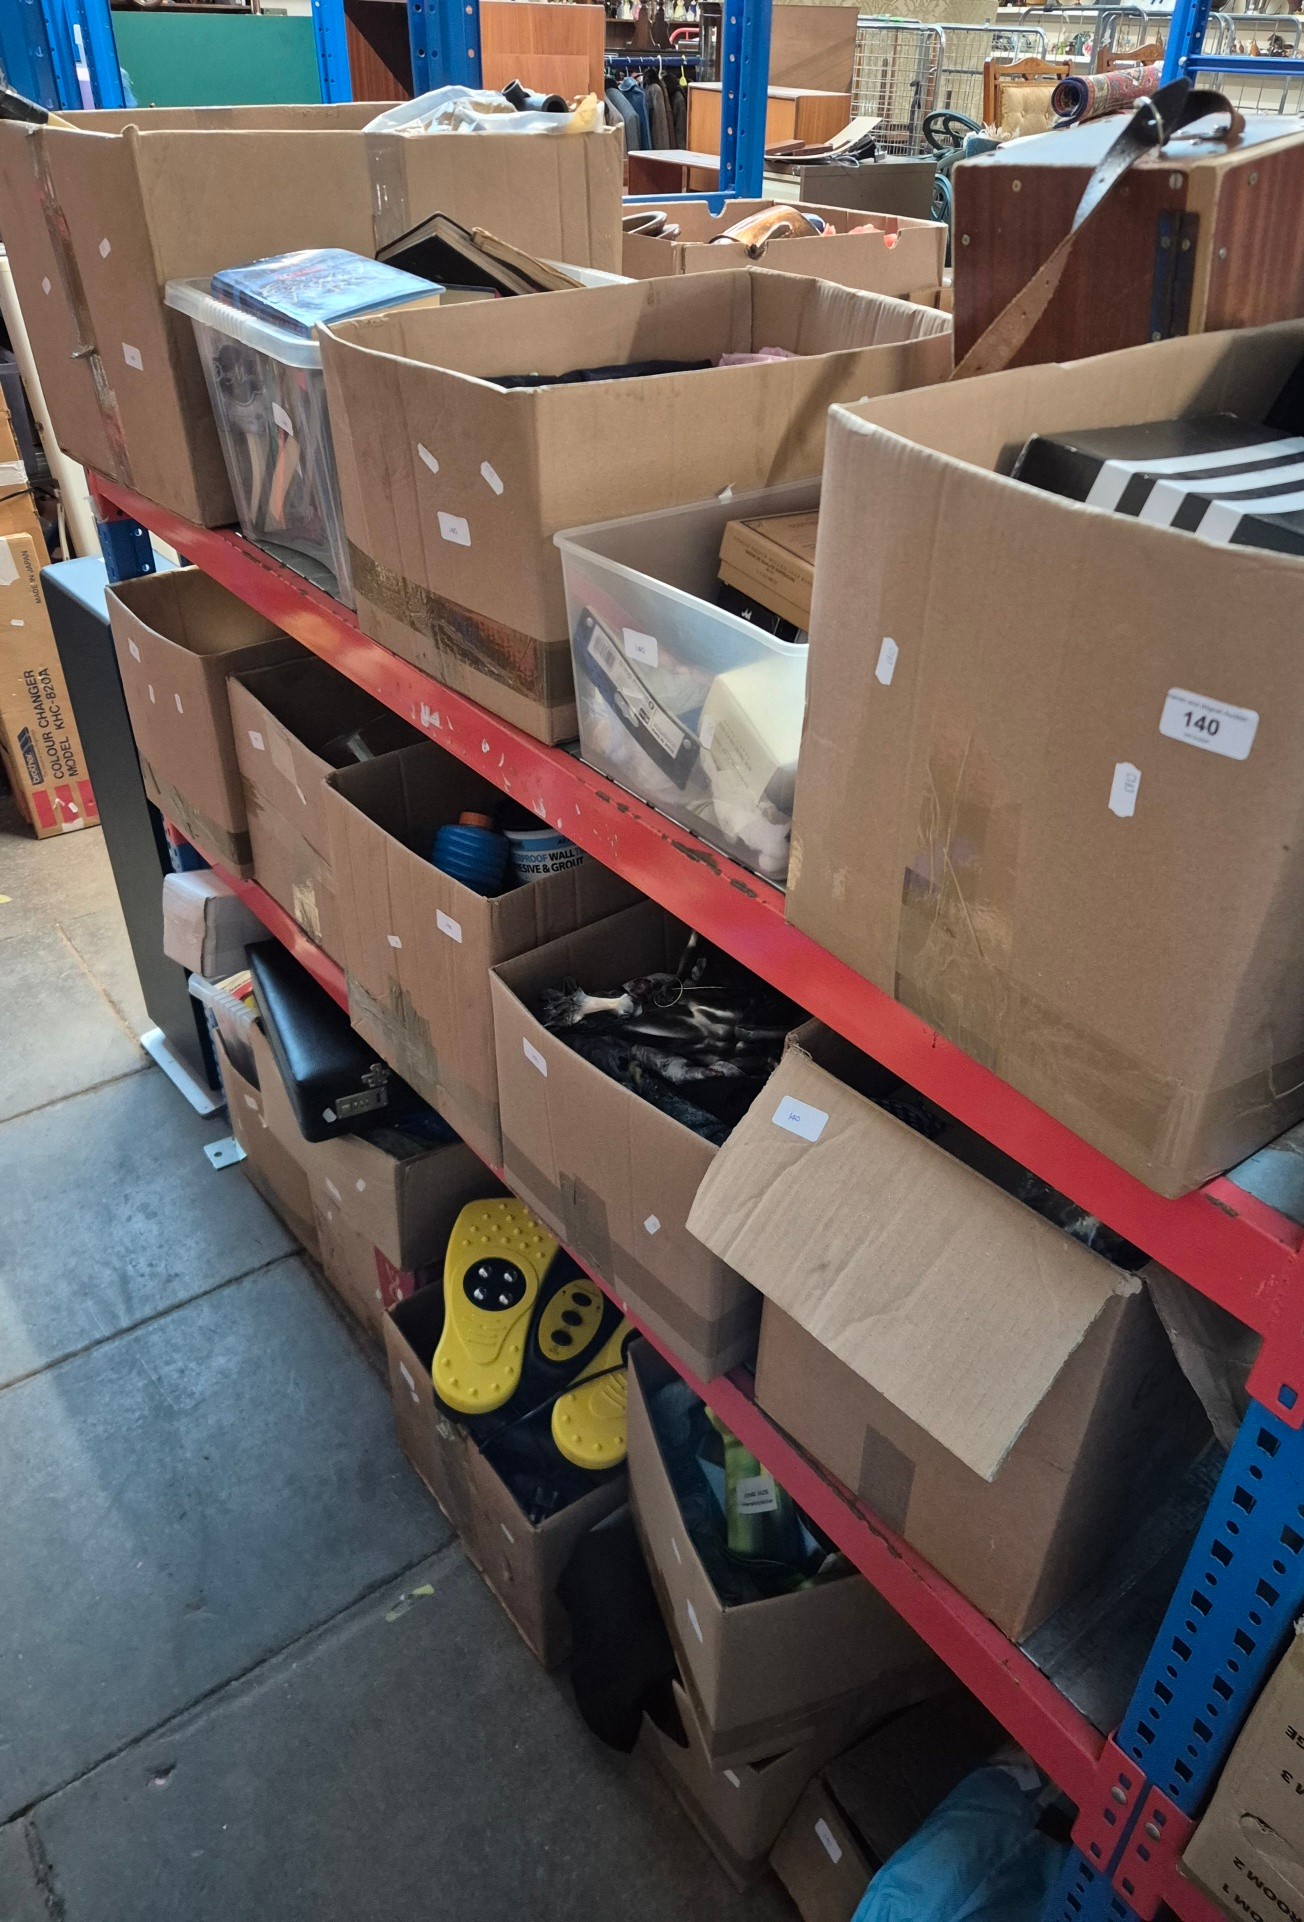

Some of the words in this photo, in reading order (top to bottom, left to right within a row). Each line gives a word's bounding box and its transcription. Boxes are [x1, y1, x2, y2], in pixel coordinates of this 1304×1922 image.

[21, 550, 34, 574] JAPAN
[29, 574, 36, 584] IN
[31, 584, 42, 604] MADE
[24, 669, 50, 728] CHANGER
[38, 668, 65, 730] KHC-820A
[1183, 711, 1220, 736] 140
[42, 731, 65, 780] COLOUR
[60, 736, 79, 777] MODEL
[26, 753, 41, 784] brother
[542, 863, 551, 873] &
[551, 856, 584, 872] GROUT
[549, 850, 574, 861] WALL
[788, 1112, 801, 1122] 140
[1233, 1856, 1245, 1870] 2
[1222, 1883, 1230, 1894] 1
